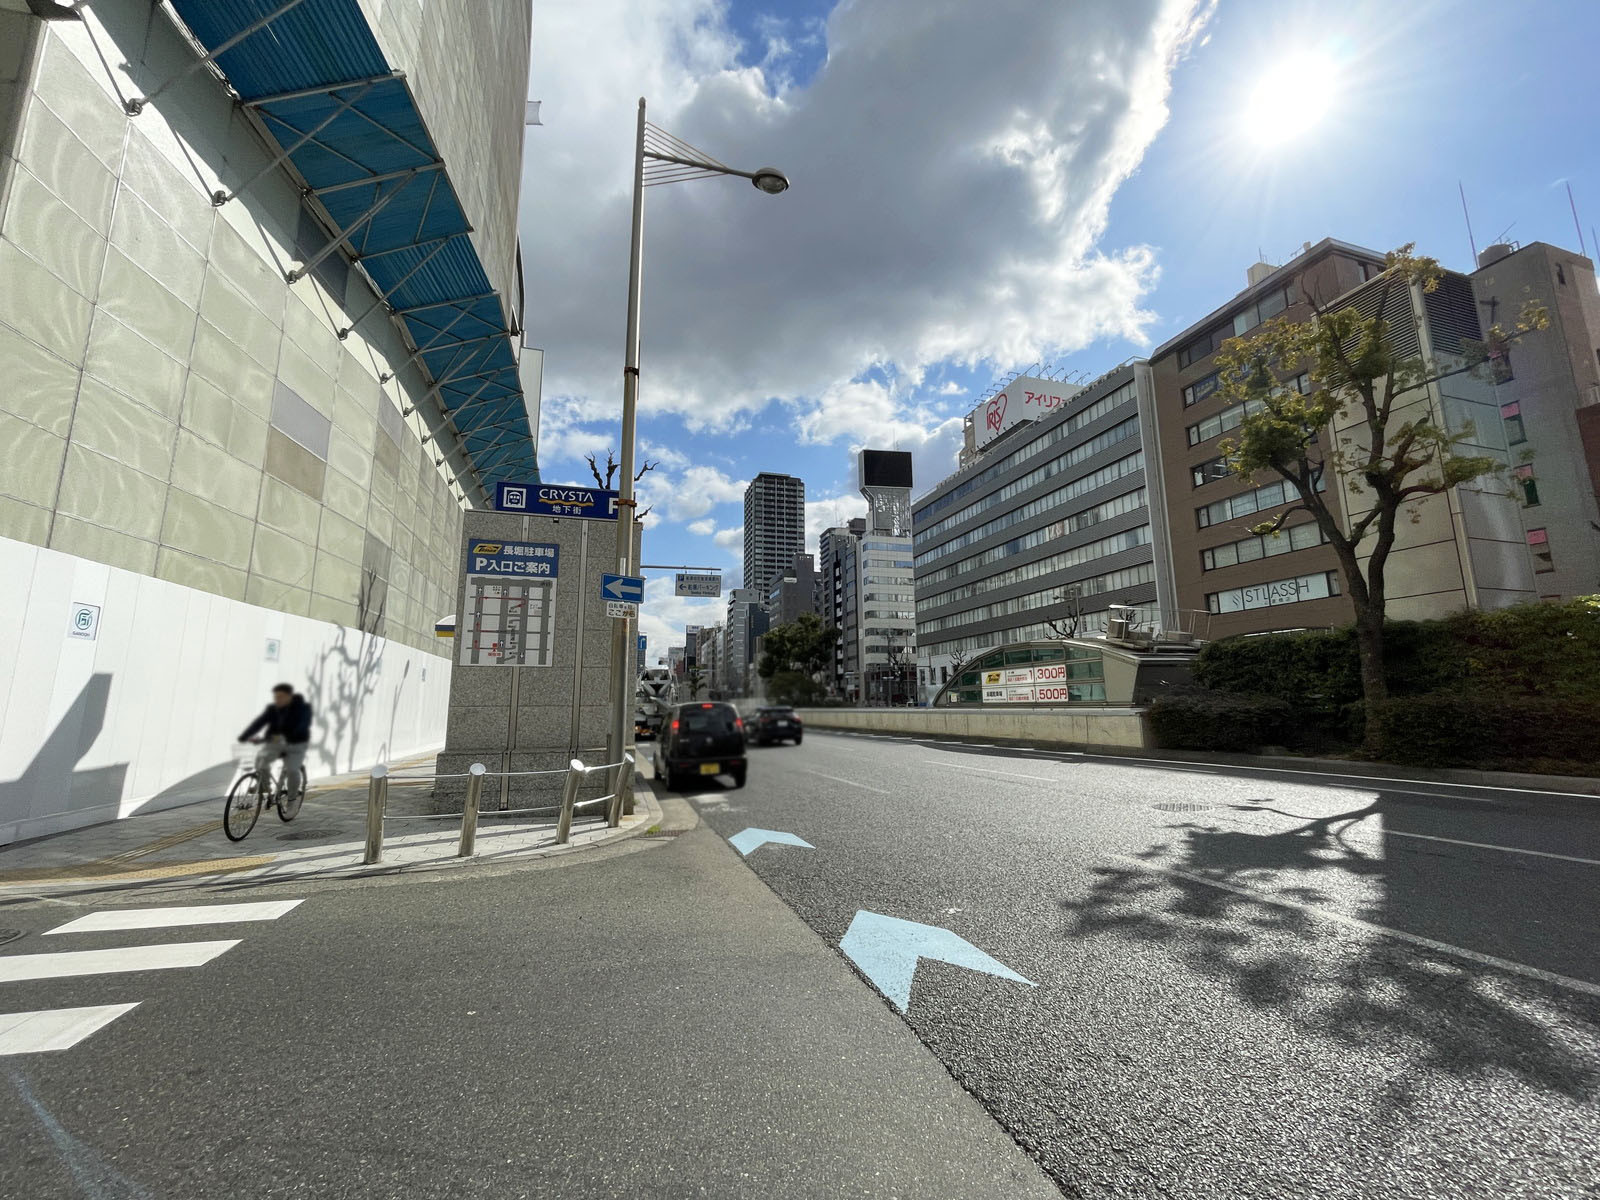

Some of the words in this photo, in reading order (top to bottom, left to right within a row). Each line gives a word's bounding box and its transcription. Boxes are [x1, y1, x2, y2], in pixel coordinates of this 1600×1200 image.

[539, 488, 594, 503] CRYSTA
[552, 505, 582, 515] 地下街
[503, 545, 555, 558] 長堀駐車場
[1245, 579, 1310, 603] STLASSH
